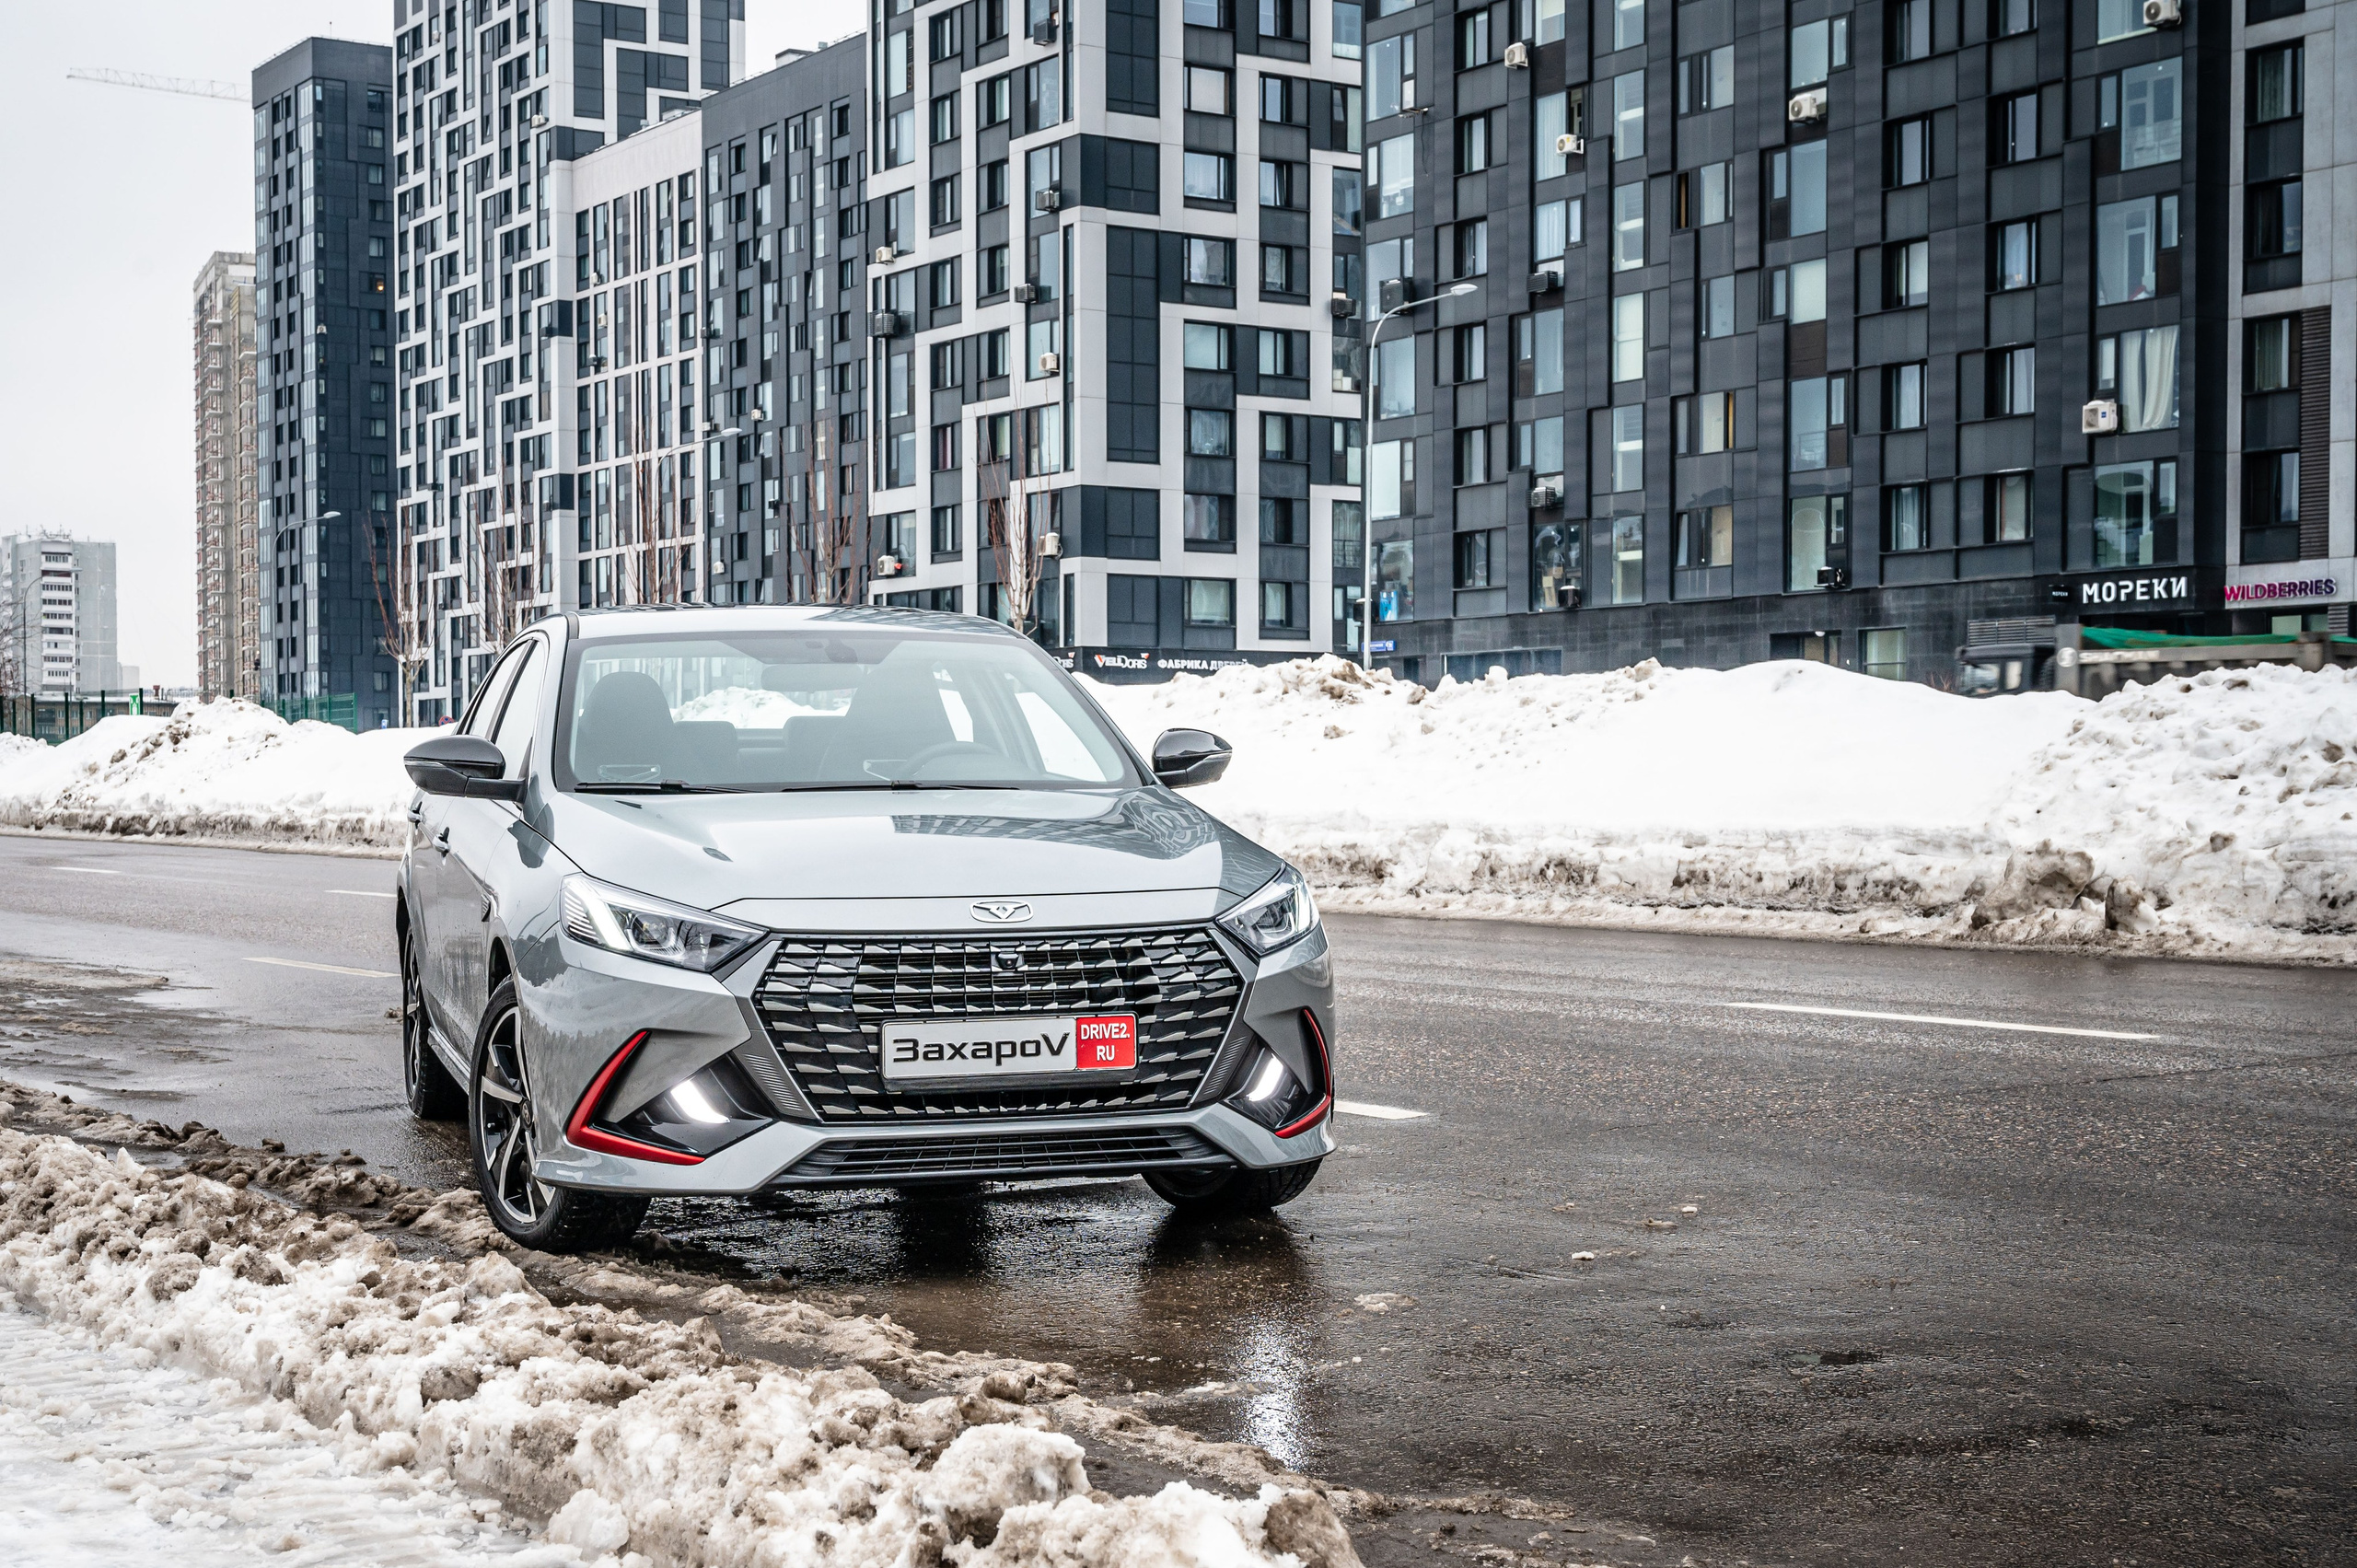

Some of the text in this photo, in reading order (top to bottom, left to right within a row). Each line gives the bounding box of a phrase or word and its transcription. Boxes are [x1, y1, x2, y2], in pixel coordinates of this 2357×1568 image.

[2082, 576, 2188, 604] МОРЕКИ
[2223, 577, 2337, 601] WILDBERRIES
[1157, 658, 1208, 670] ФАБРИКА
[1096, 1045, 1116, 1062] RU
